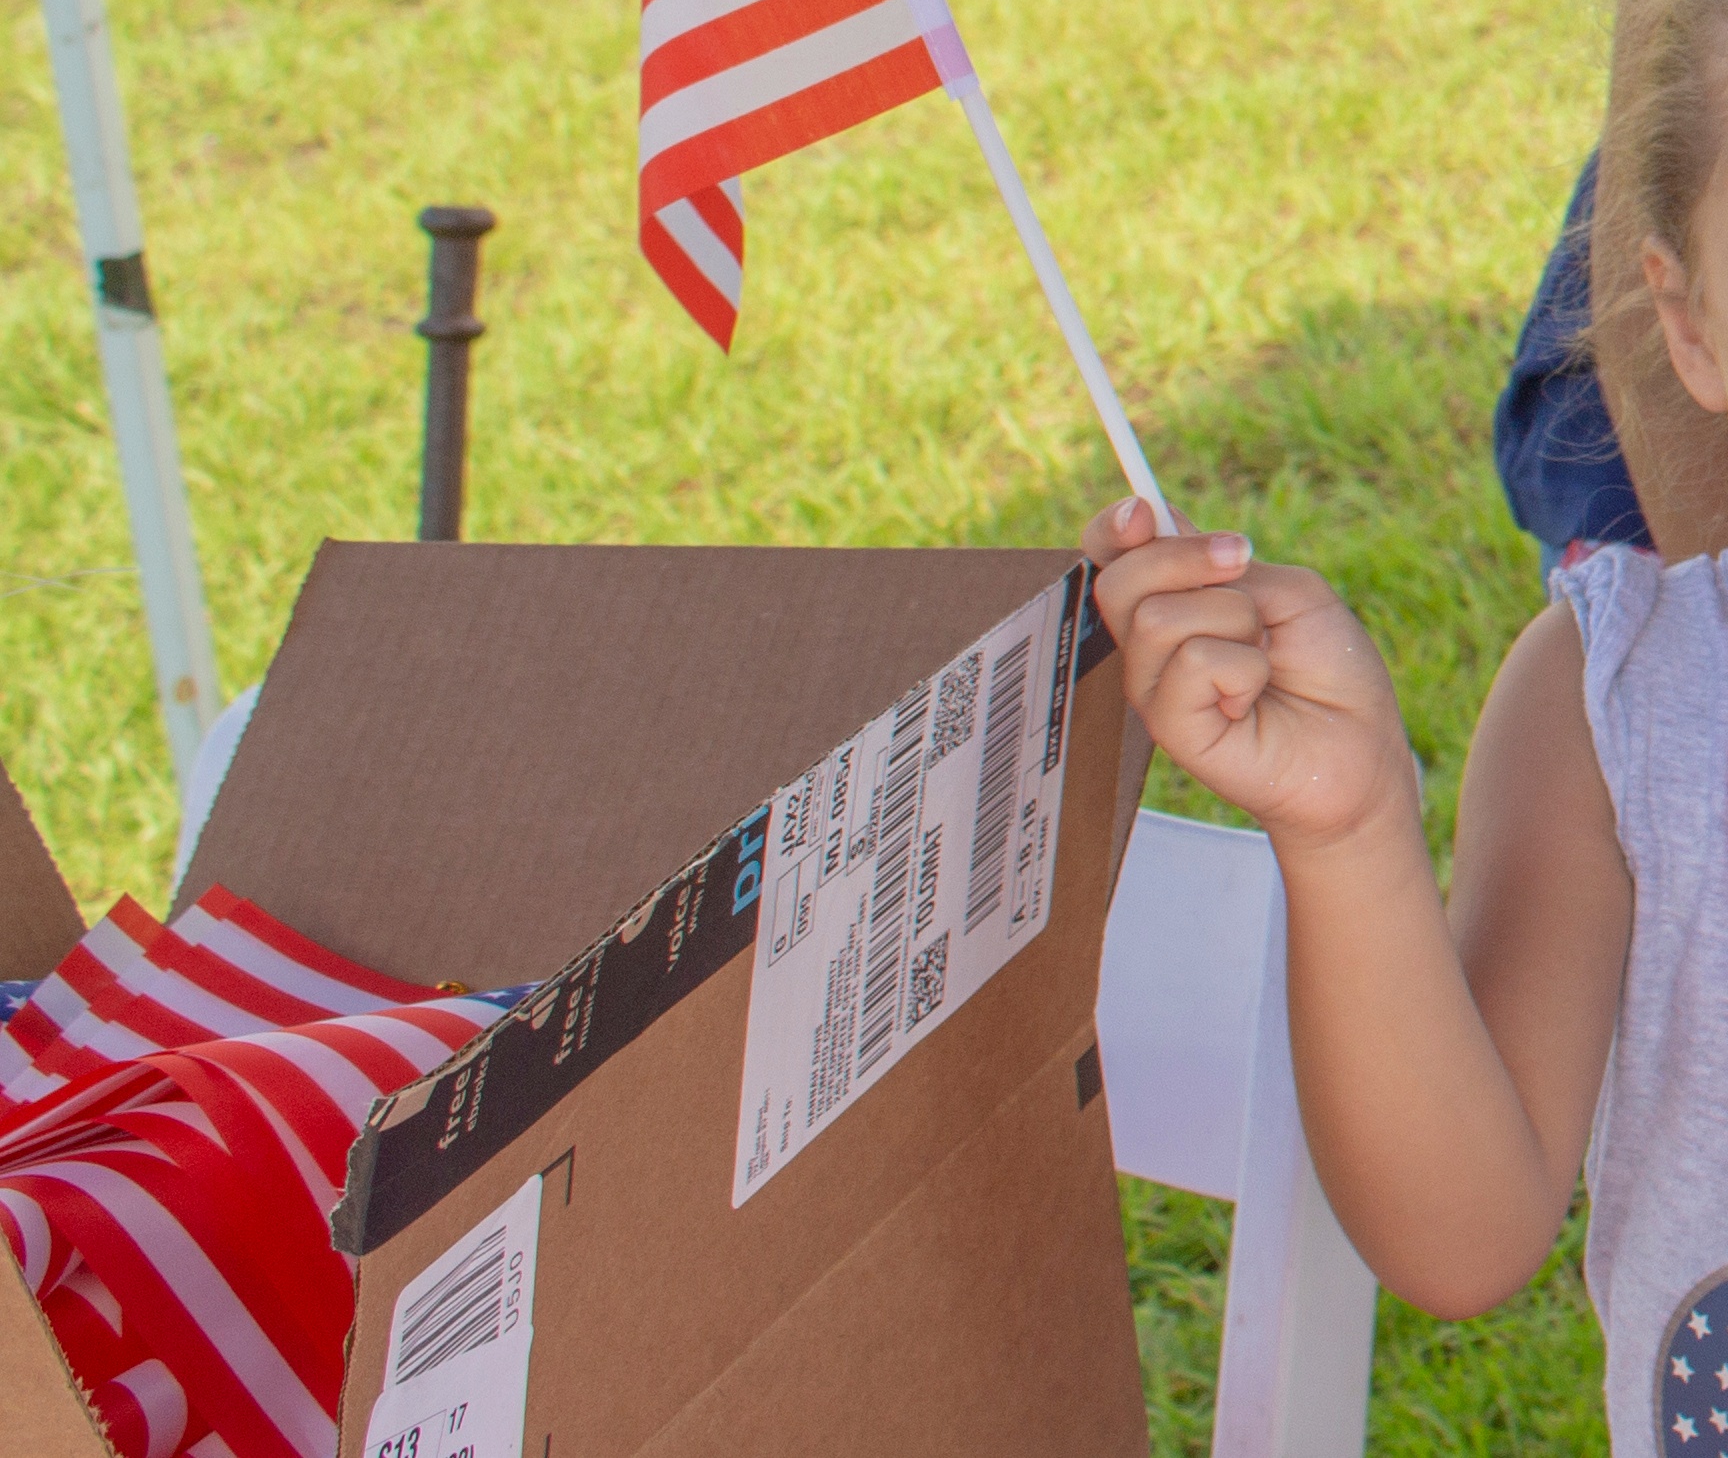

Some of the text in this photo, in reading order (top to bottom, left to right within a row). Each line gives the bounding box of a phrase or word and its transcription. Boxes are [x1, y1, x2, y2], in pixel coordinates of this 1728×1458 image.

[782, 791, 802, 855] JAX2
[915, 825, 941, 938] TOLOMAT
[669, 886, 691, 970] voice
[555, 987, 582, 1064] free
[439, 1069, 470, 1148] free
[468, 1057, 489, 1130] ebooks
[450, 1403, 469, 1434] 17
